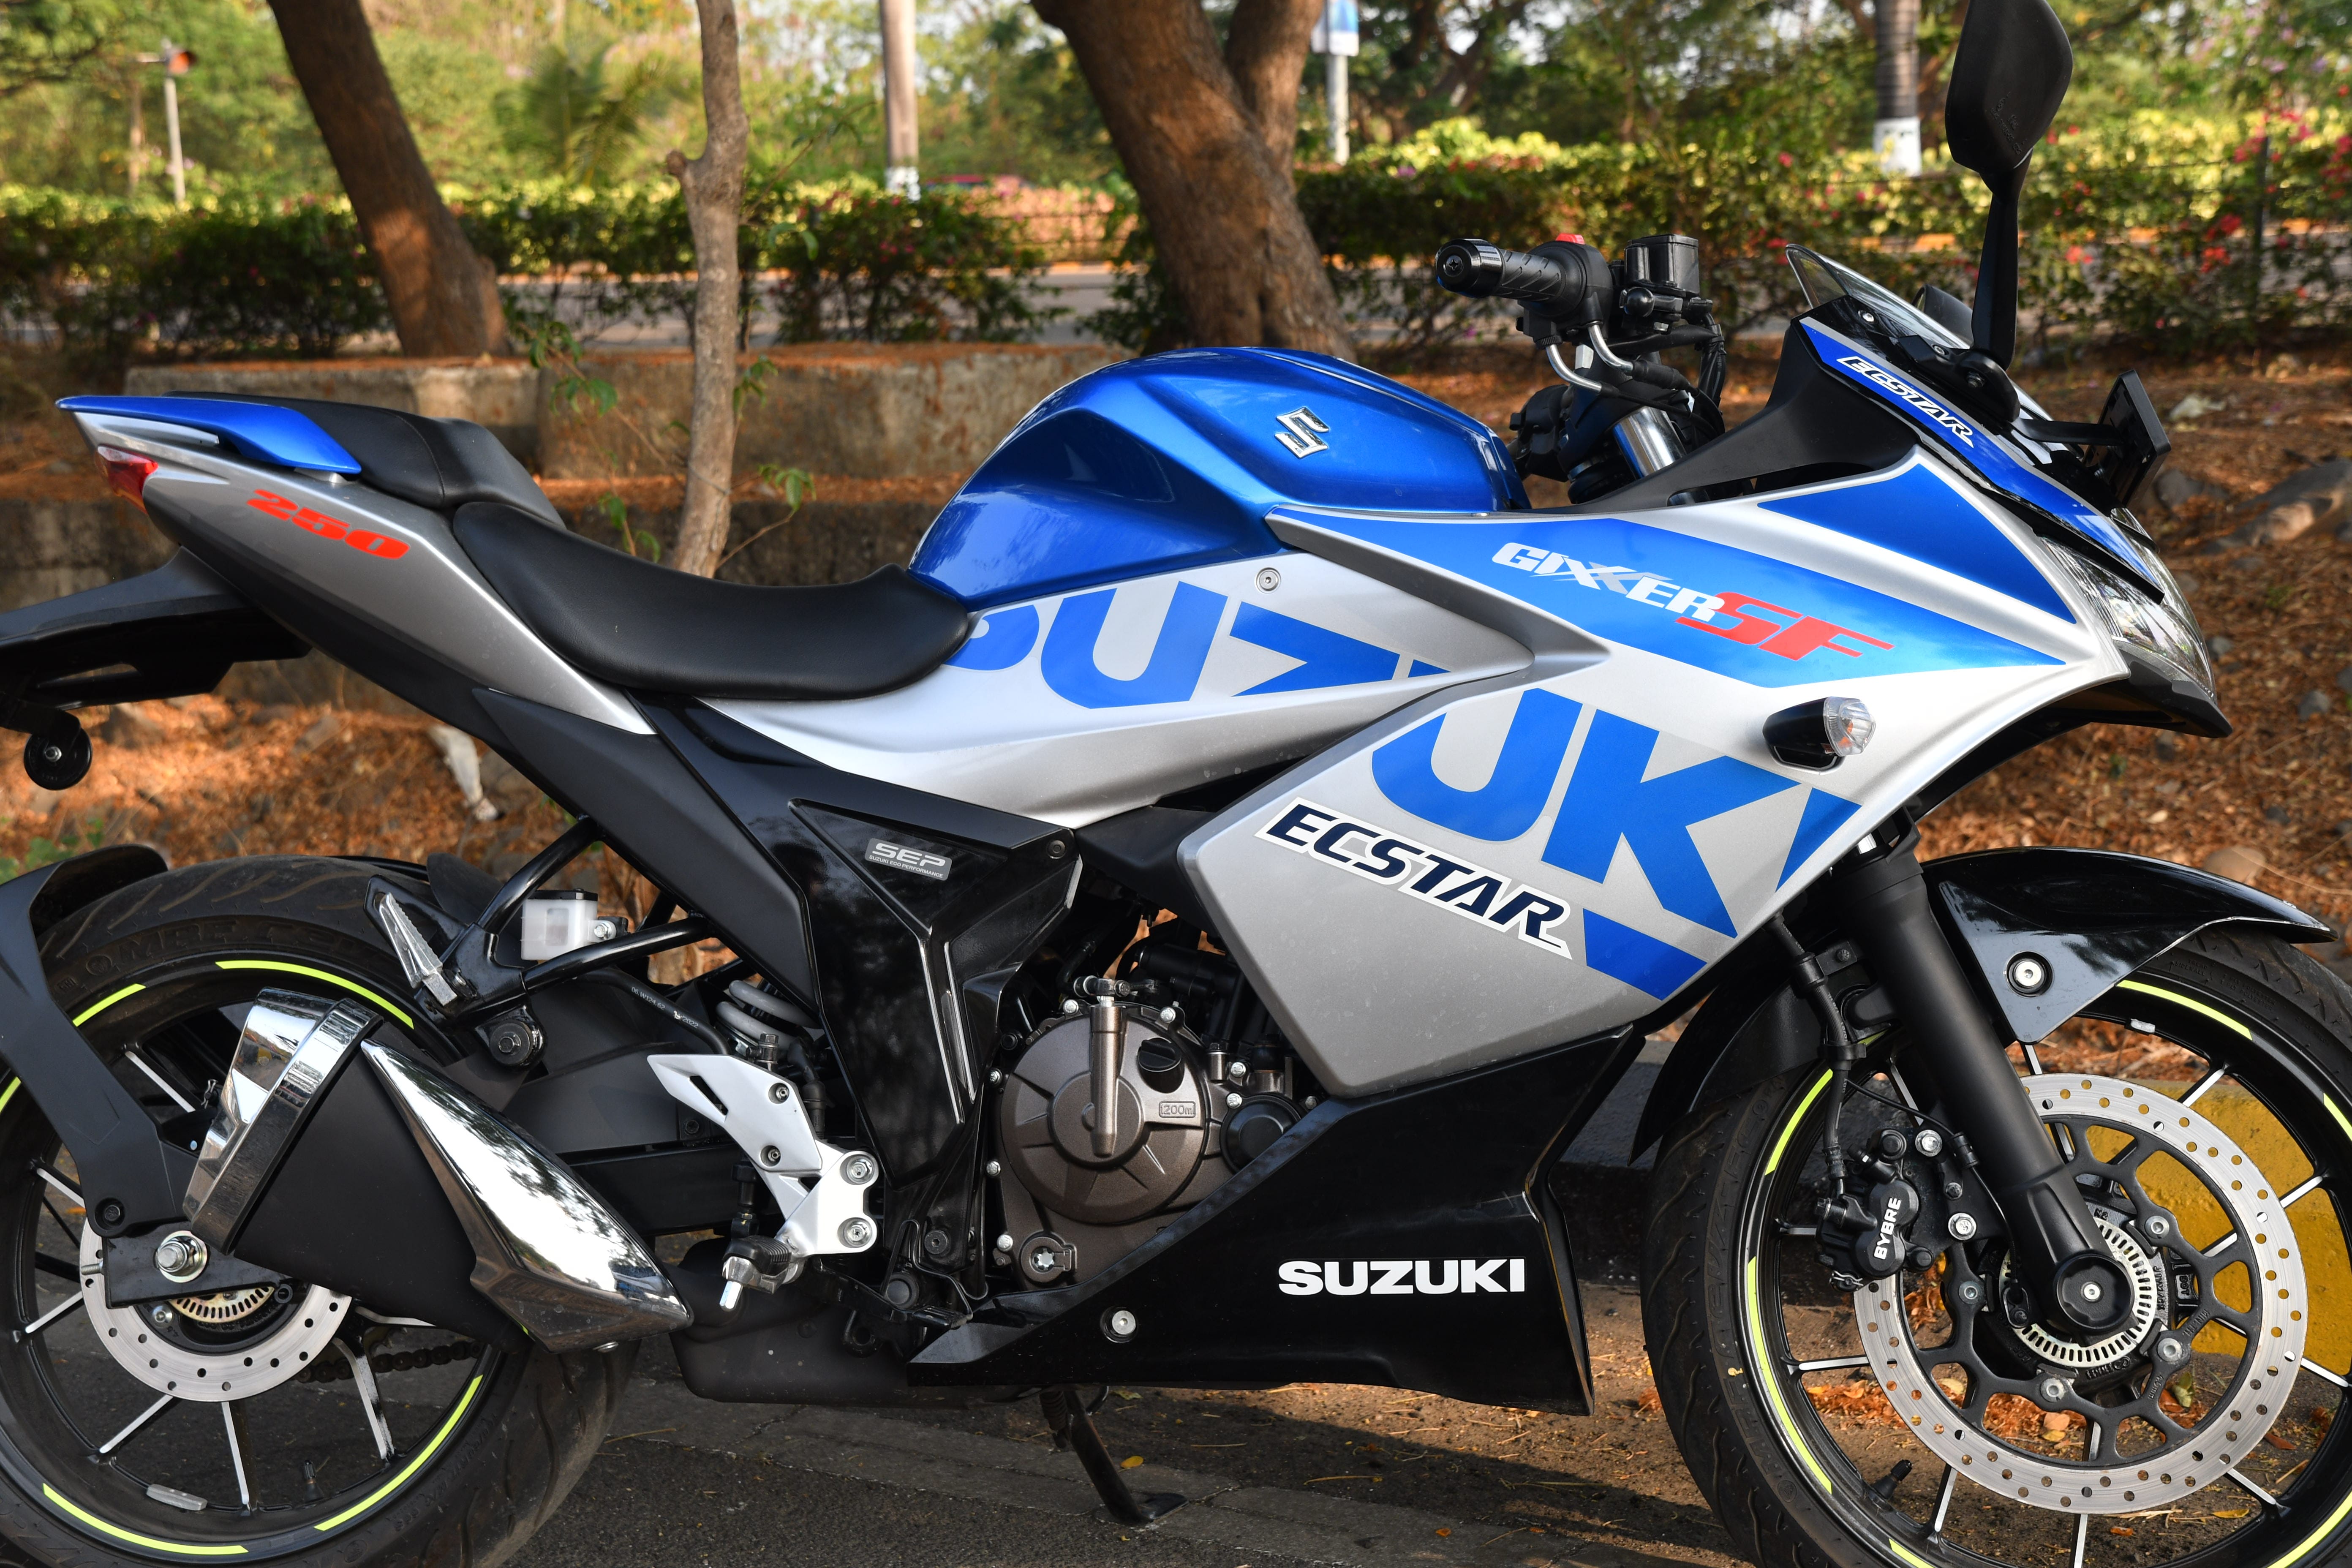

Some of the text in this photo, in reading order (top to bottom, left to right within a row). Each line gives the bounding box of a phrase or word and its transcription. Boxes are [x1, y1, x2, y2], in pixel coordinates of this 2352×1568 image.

[1840, 357, 1973, 447] ECSTAR
[246, 489, 410, 559] 250
[1492, 542, 1896, 661] GIXXER SF
[869, 855, 889, 864] SUZUKI
[902, 863, 943, 878] PERFORMANCE
[872, 843, 946, 866] SEP
[1260, 800, 1567, 955] ECSTAR
[1160, 1104, 1195, 1115] 1200ml
[1874, 1198, 1901, 1260] BYBRE
[1278, 1258, 1525, 1296] SUZUKI
[2181, 1275, 2190, 1296] DOT
